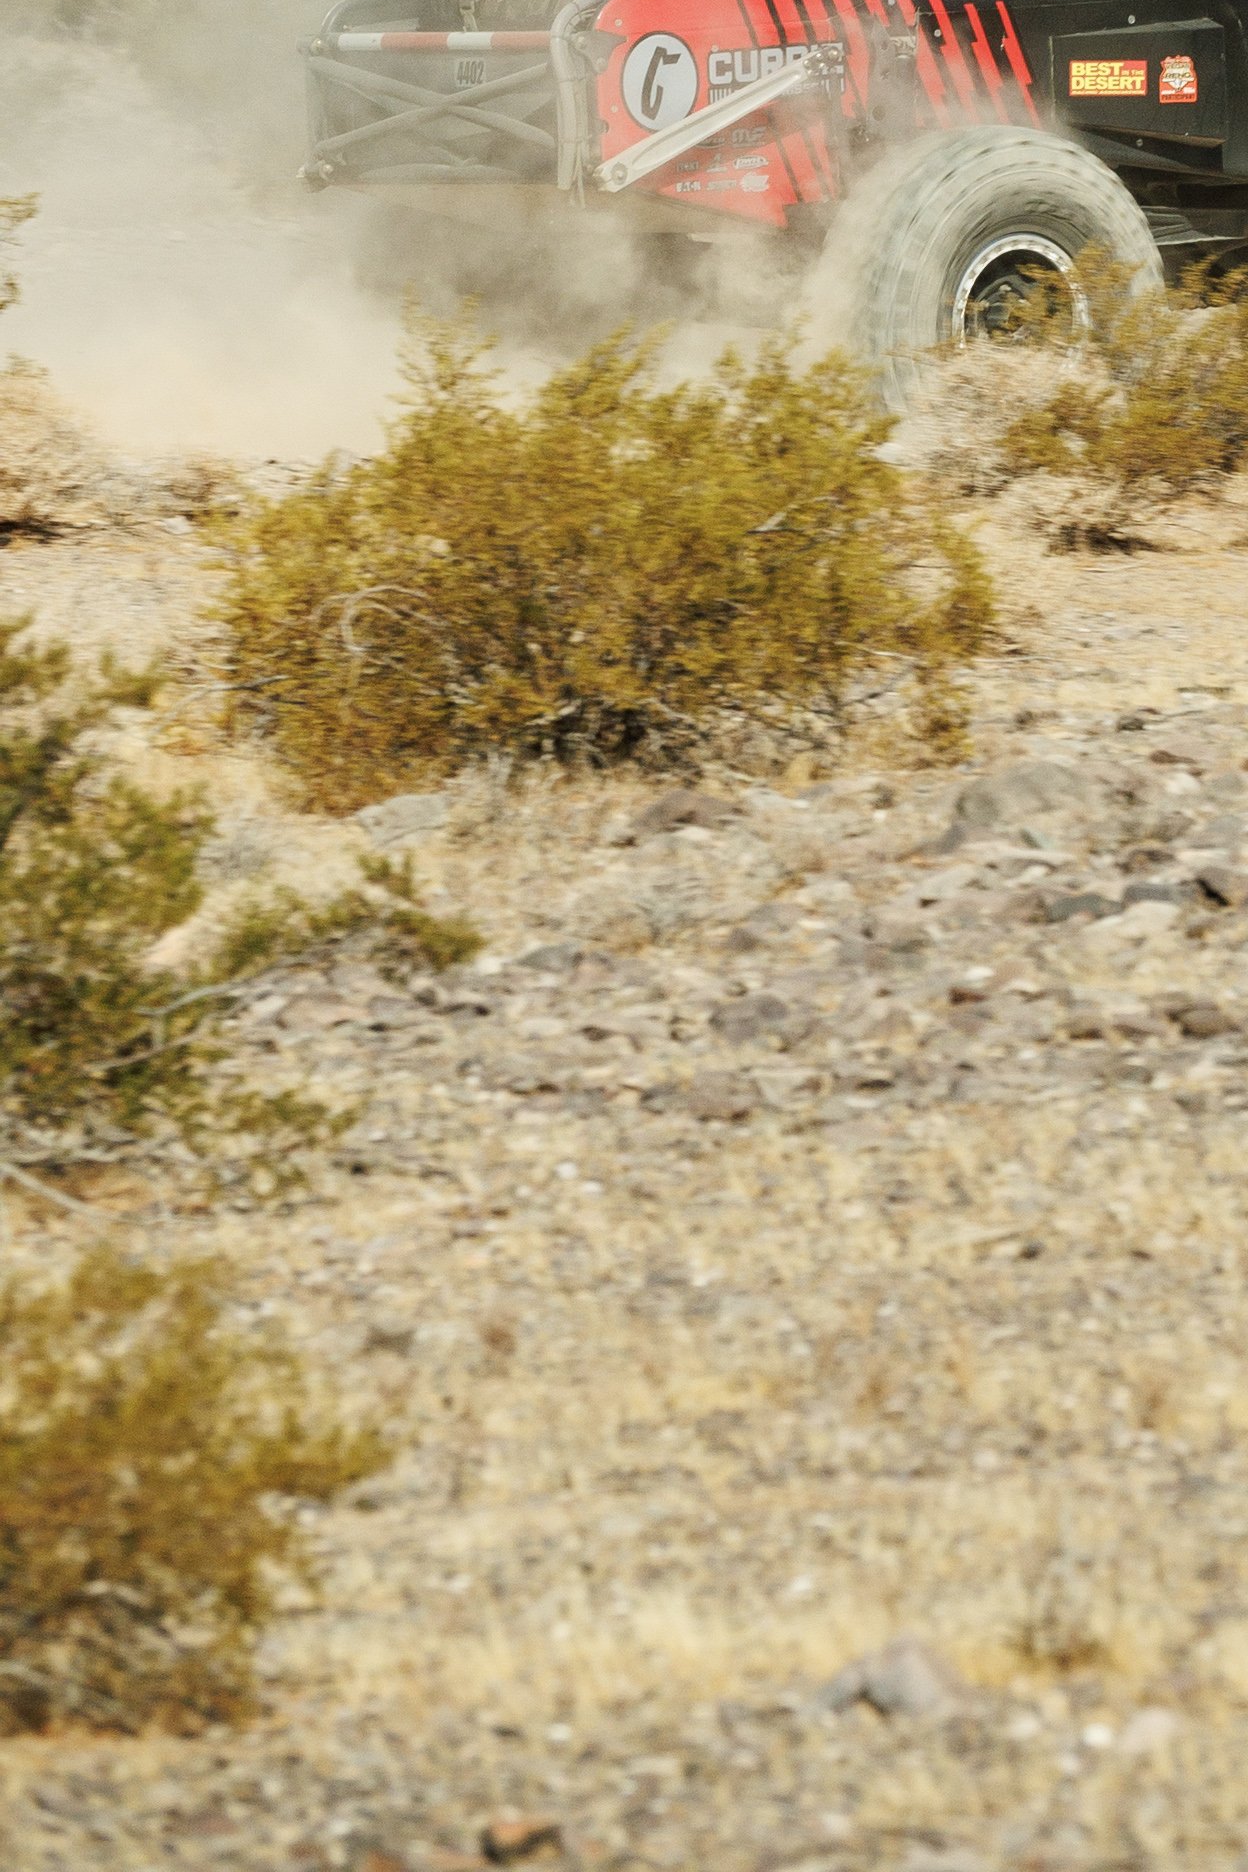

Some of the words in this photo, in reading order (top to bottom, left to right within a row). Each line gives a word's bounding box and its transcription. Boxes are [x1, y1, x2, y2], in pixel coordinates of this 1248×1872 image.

[457, 60, 485, 85] 4402
[1071, 62, 1124, 76] BEST
[1071, 76, 1145, 90] DESERT
